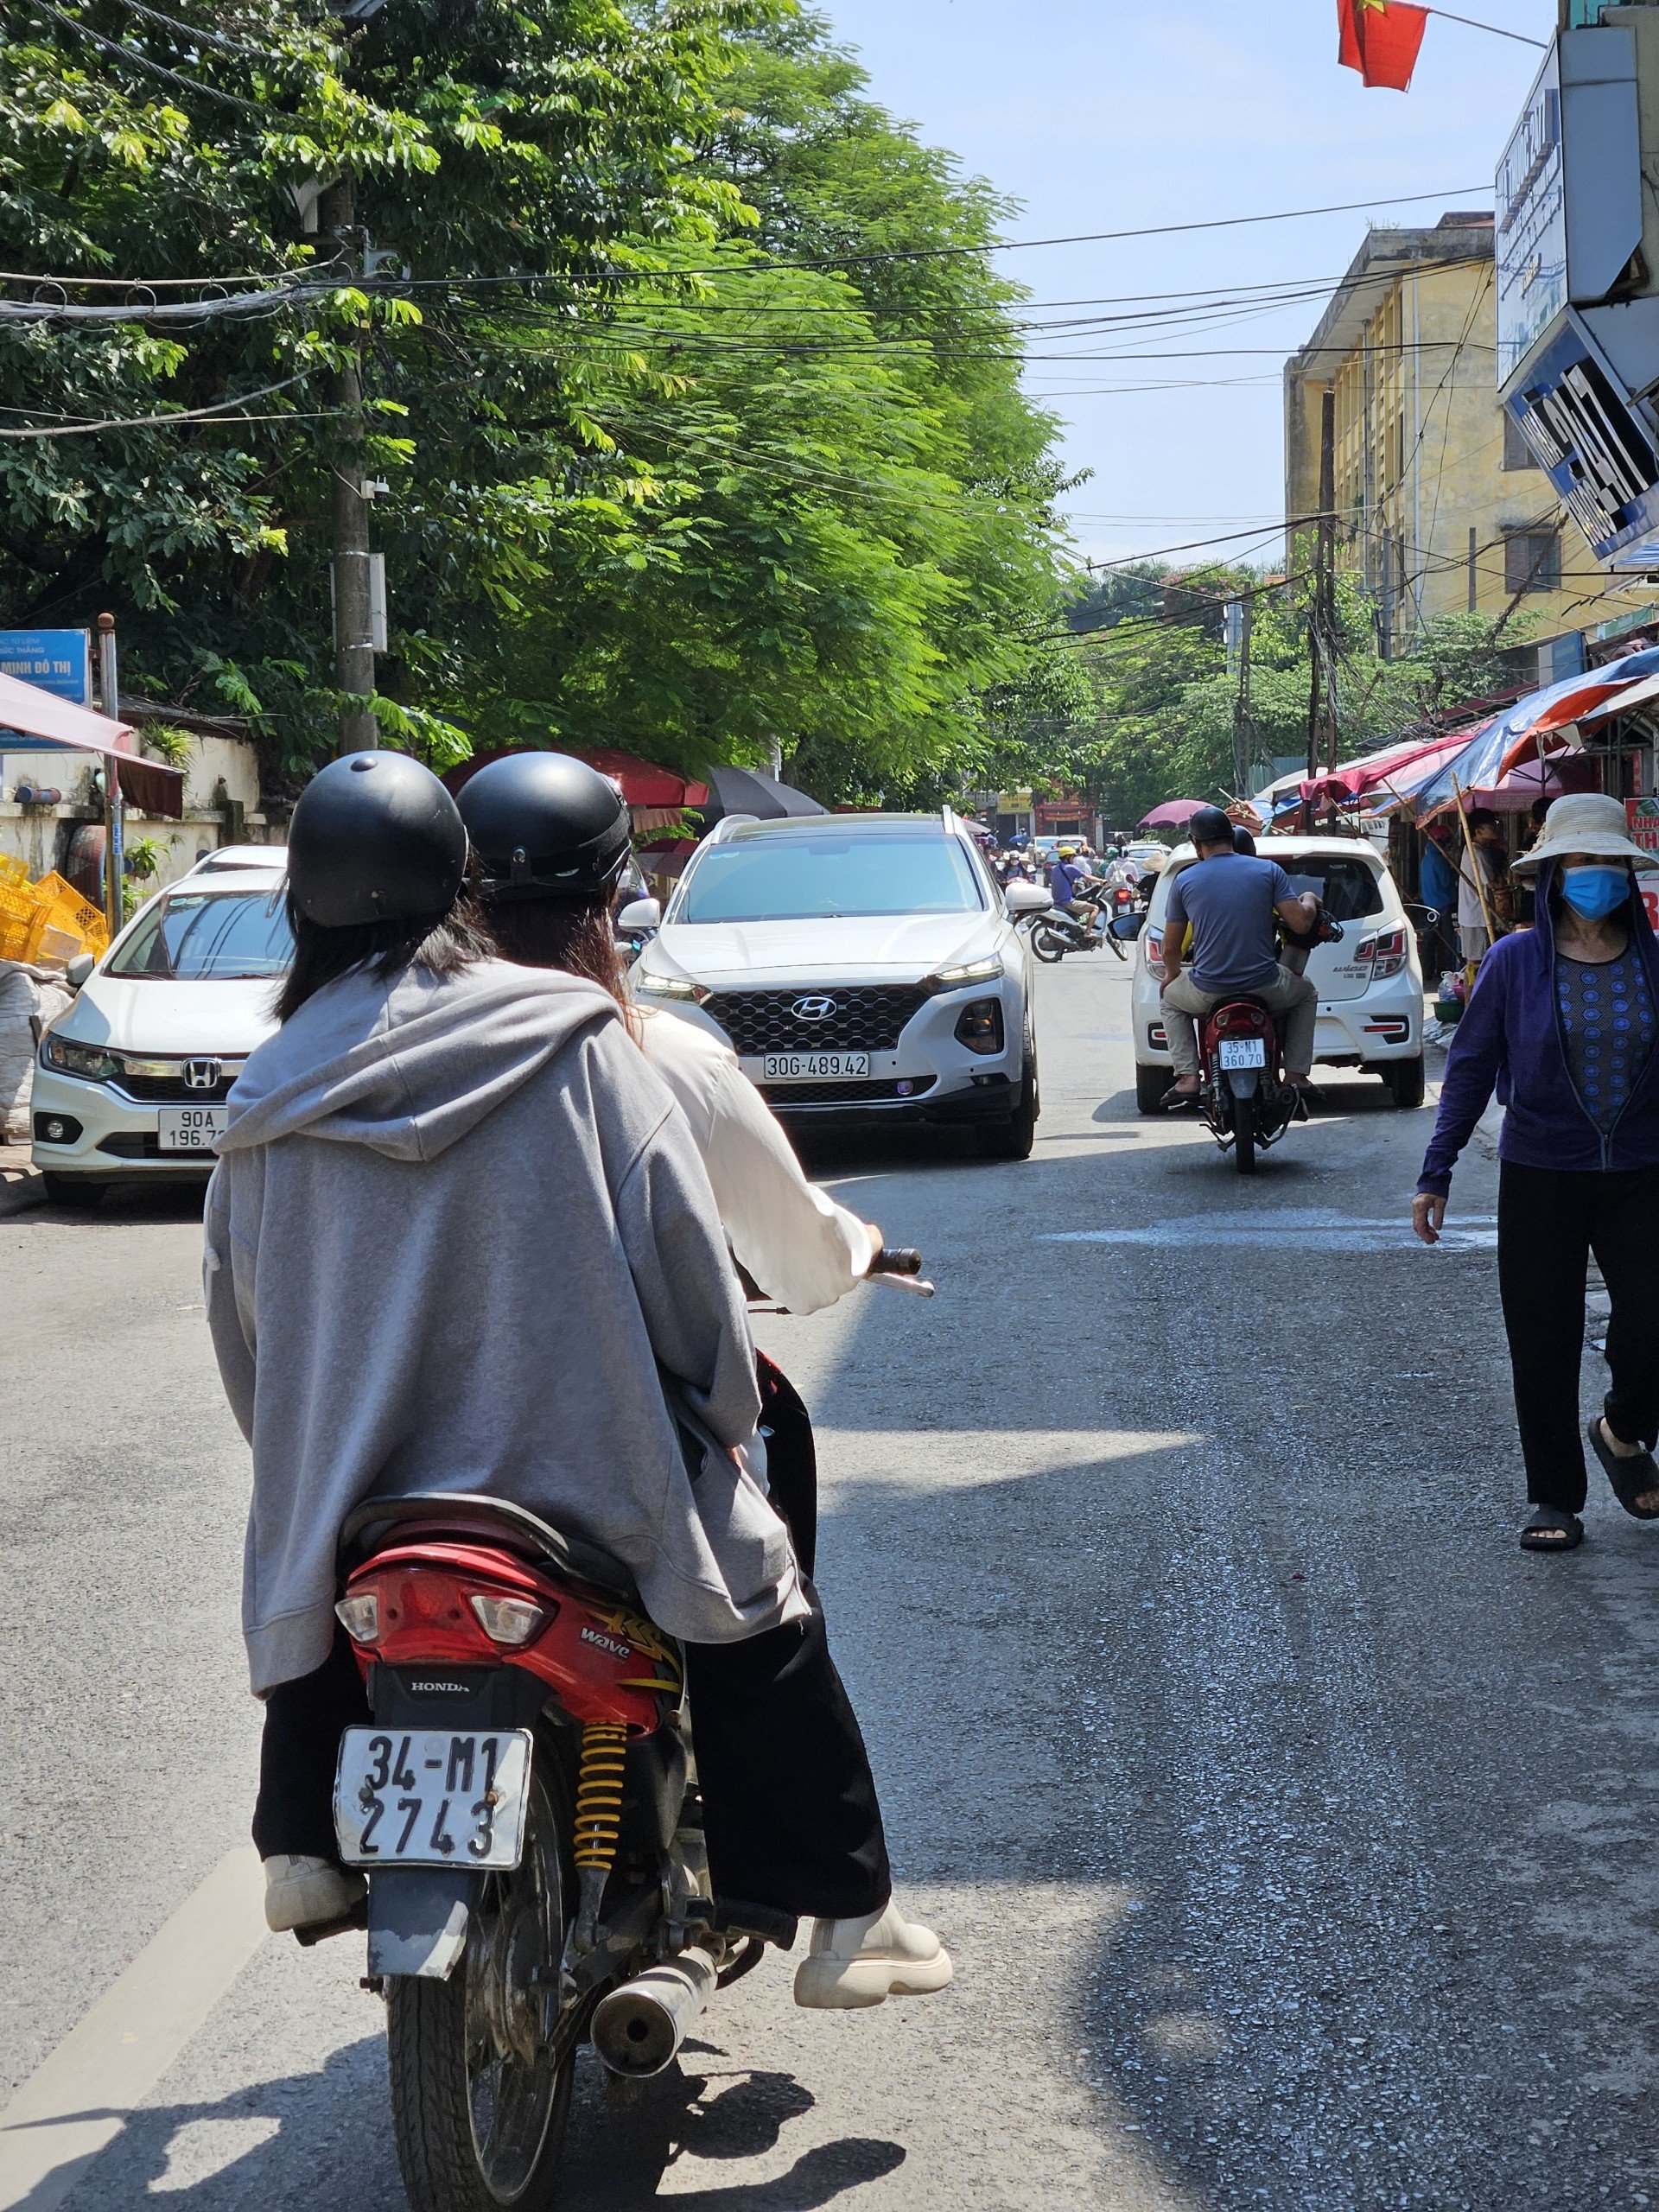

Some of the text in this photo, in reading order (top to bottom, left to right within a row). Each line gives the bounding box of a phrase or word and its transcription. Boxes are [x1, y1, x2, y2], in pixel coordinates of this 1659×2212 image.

[1522, 393, 1565, 469] NHÀ
[1543, 365, 1649, 514] 24/7
[1560, 464, 1617, 548] THUỐC
[1, 658, 71, 676] MINH ĐÔ THỊ
[767, 1056, 867, 1076] 30G-489.42
[1224, 1053, 1262, 1067] 360.70
[181, 1111, 214, 1128] 90A
[169, 1130, 226, 1147] 196.7
[410, 1681, 471, 1693] HONDA
[365, 1735, 499, 1792] 34-M1
[359, 1797, 497, 1859] 2743
